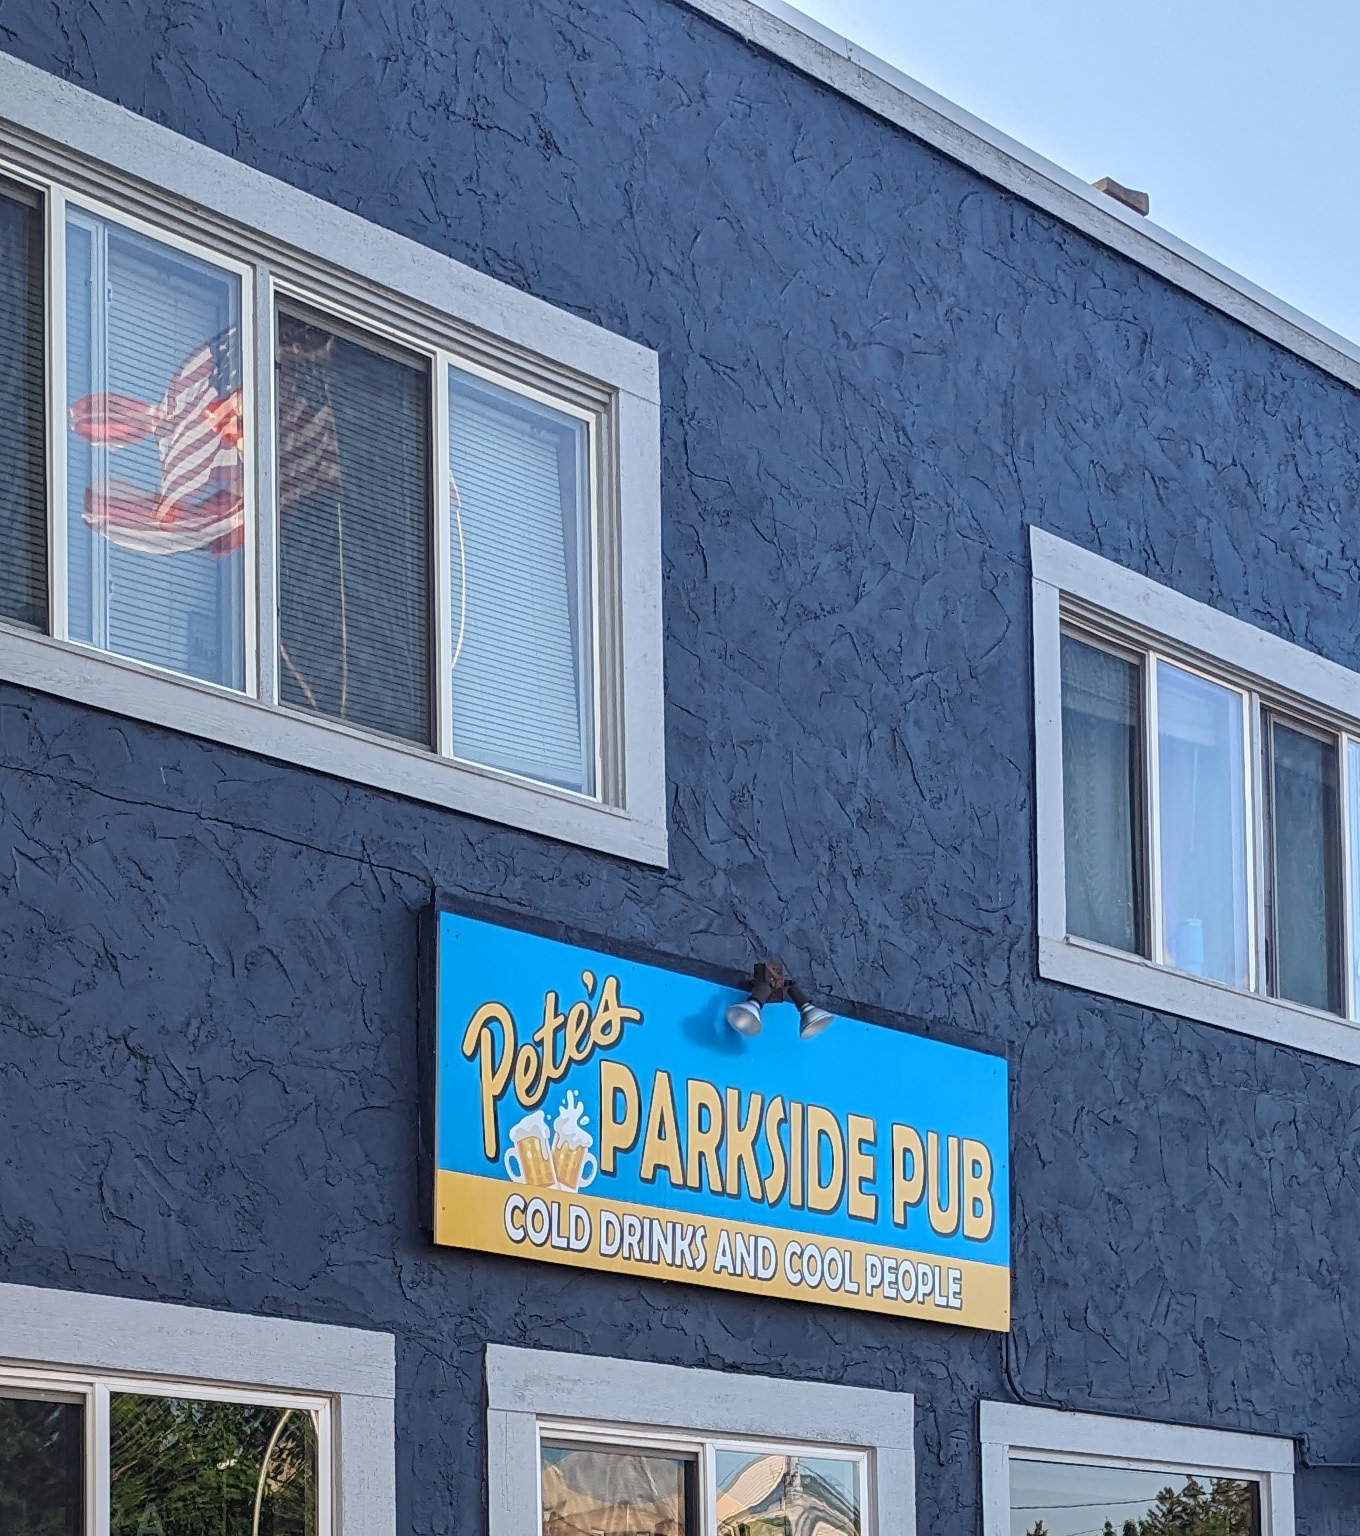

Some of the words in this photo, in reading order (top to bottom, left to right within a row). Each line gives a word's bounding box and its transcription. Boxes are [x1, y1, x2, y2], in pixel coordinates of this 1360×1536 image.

[461, 969, 642, 1161] Pete's
[598, 1059, 879, 1222] PARKSIDE
[891, 1122, 996, 1243] PUB
[504, 1192, 592, 1252] COLD
[599, 1209, 708, 1271] DRINKS
[713, 1229, 777, 1281] AND
[784, 1240, 860, 1295] COOL
[864, 1254, 963, 1310] PEOPLE
